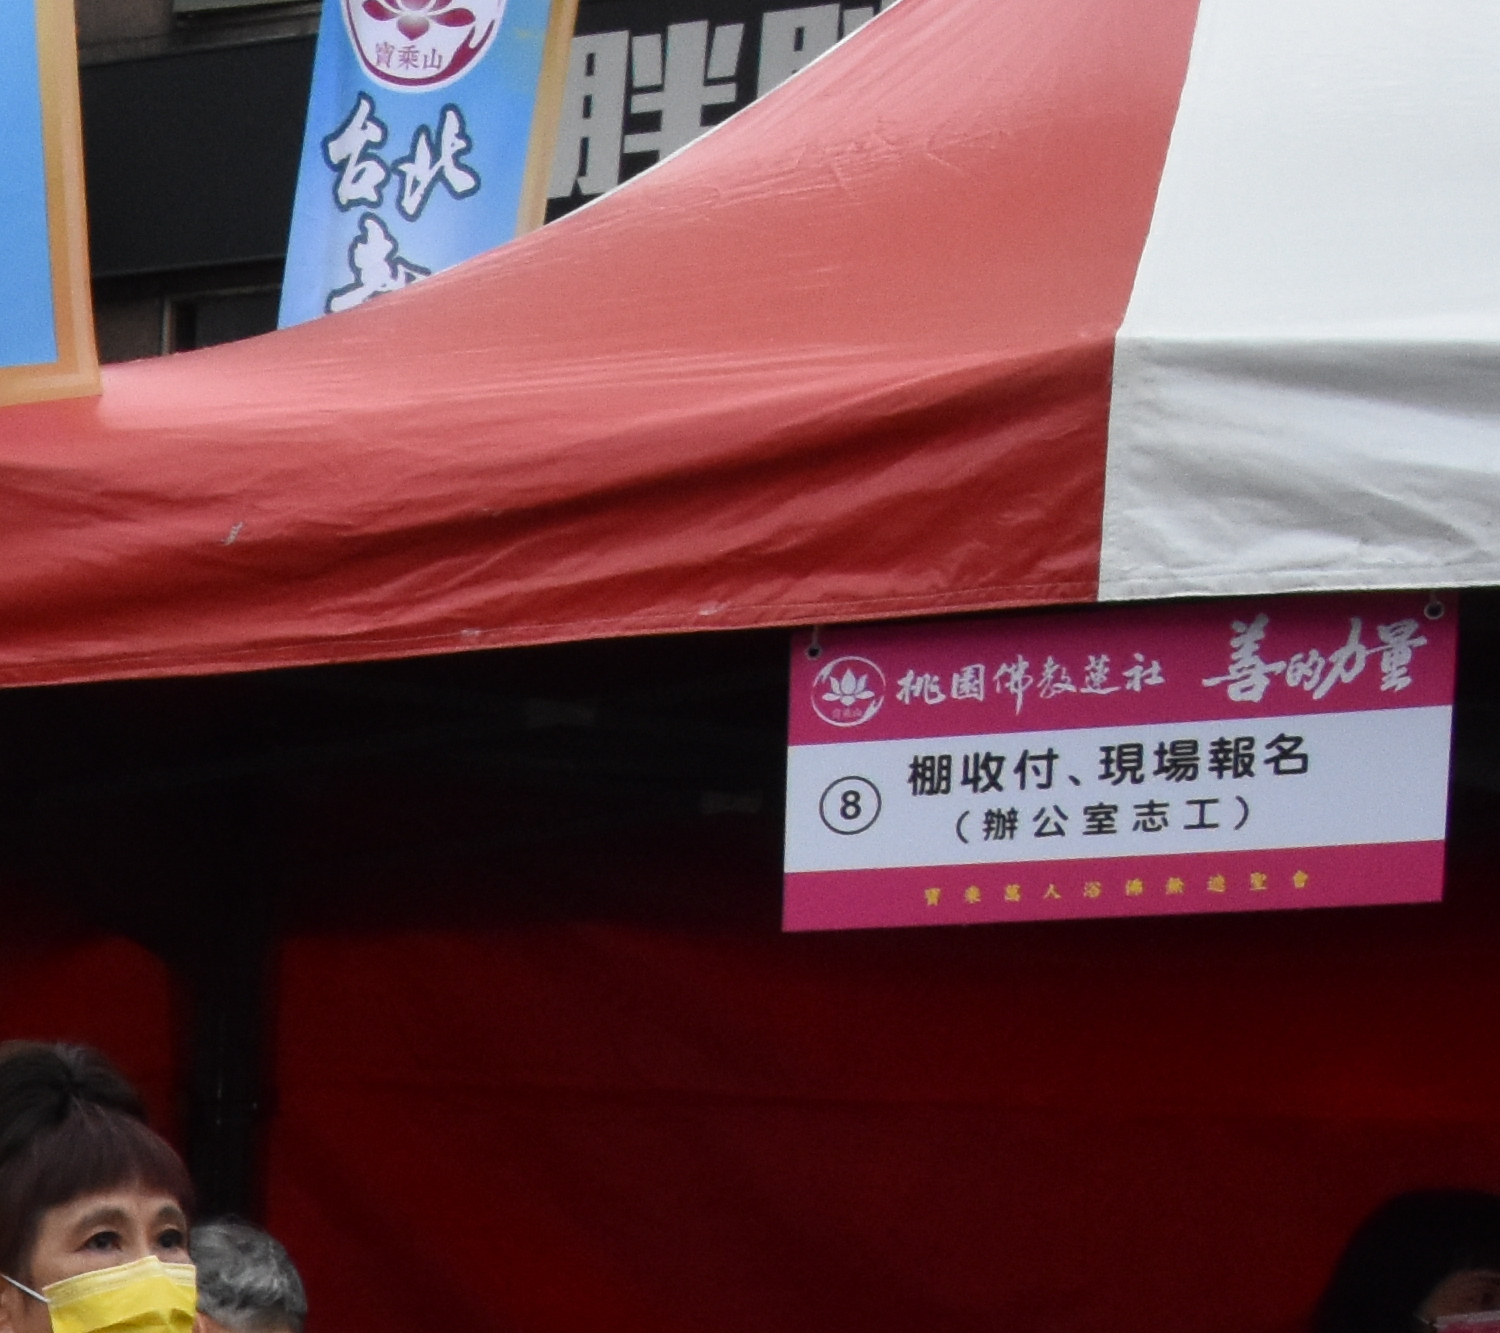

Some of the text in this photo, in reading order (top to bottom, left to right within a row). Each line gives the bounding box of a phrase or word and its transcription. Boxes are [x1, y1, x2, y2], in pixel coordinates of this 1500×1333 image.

[327, 98, 477, 215] 台北
[1201, 613, 1428, 704] 善的力量
[906, 733, 1309, 799] 棚收付、現場報名
